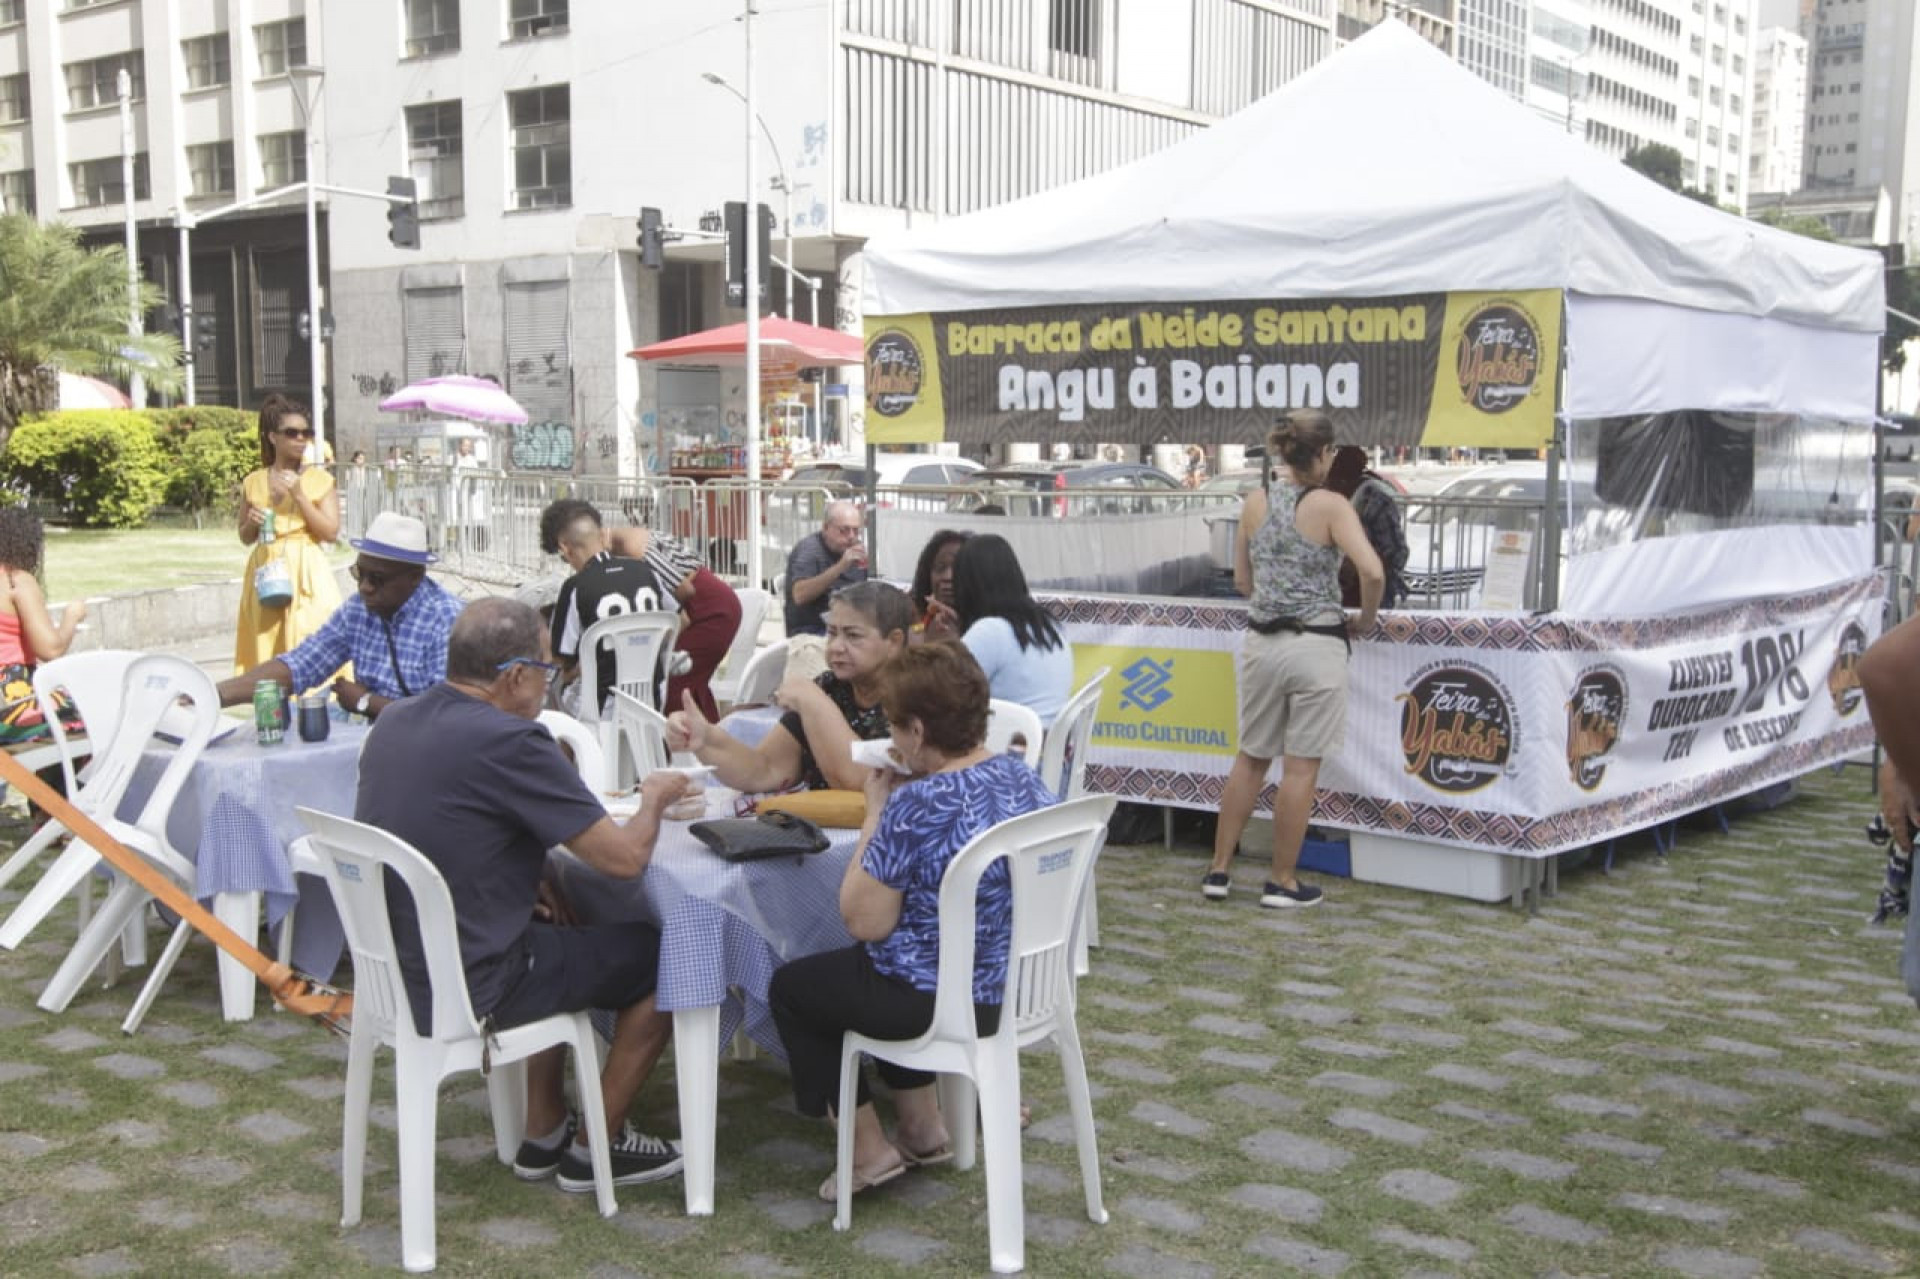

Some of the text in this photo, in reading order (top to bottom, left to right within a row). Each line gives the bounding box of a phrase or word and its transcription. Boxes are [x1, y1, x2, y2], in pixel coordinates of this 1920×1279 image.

[948, 321, 1081, 356] Barraca
[1090, 317, 1132, 351] da
[1140, 308, 1243, 348] Neide
[1254, 304, 1426, 346] Santana
[998, 354, 1360, 421] Angu à Baiana
[1668, 651, 1733, 692] CLIENTES
[1421, 681, 1480, 716] Feira
[1647, 688, 1737, 732] OUROCARD
[1092, 721, 1231, 748] NTRO CULTURAL
[1394, 692, 1508, 774] Yabás
[1724, 726, 1747, 752] DE
